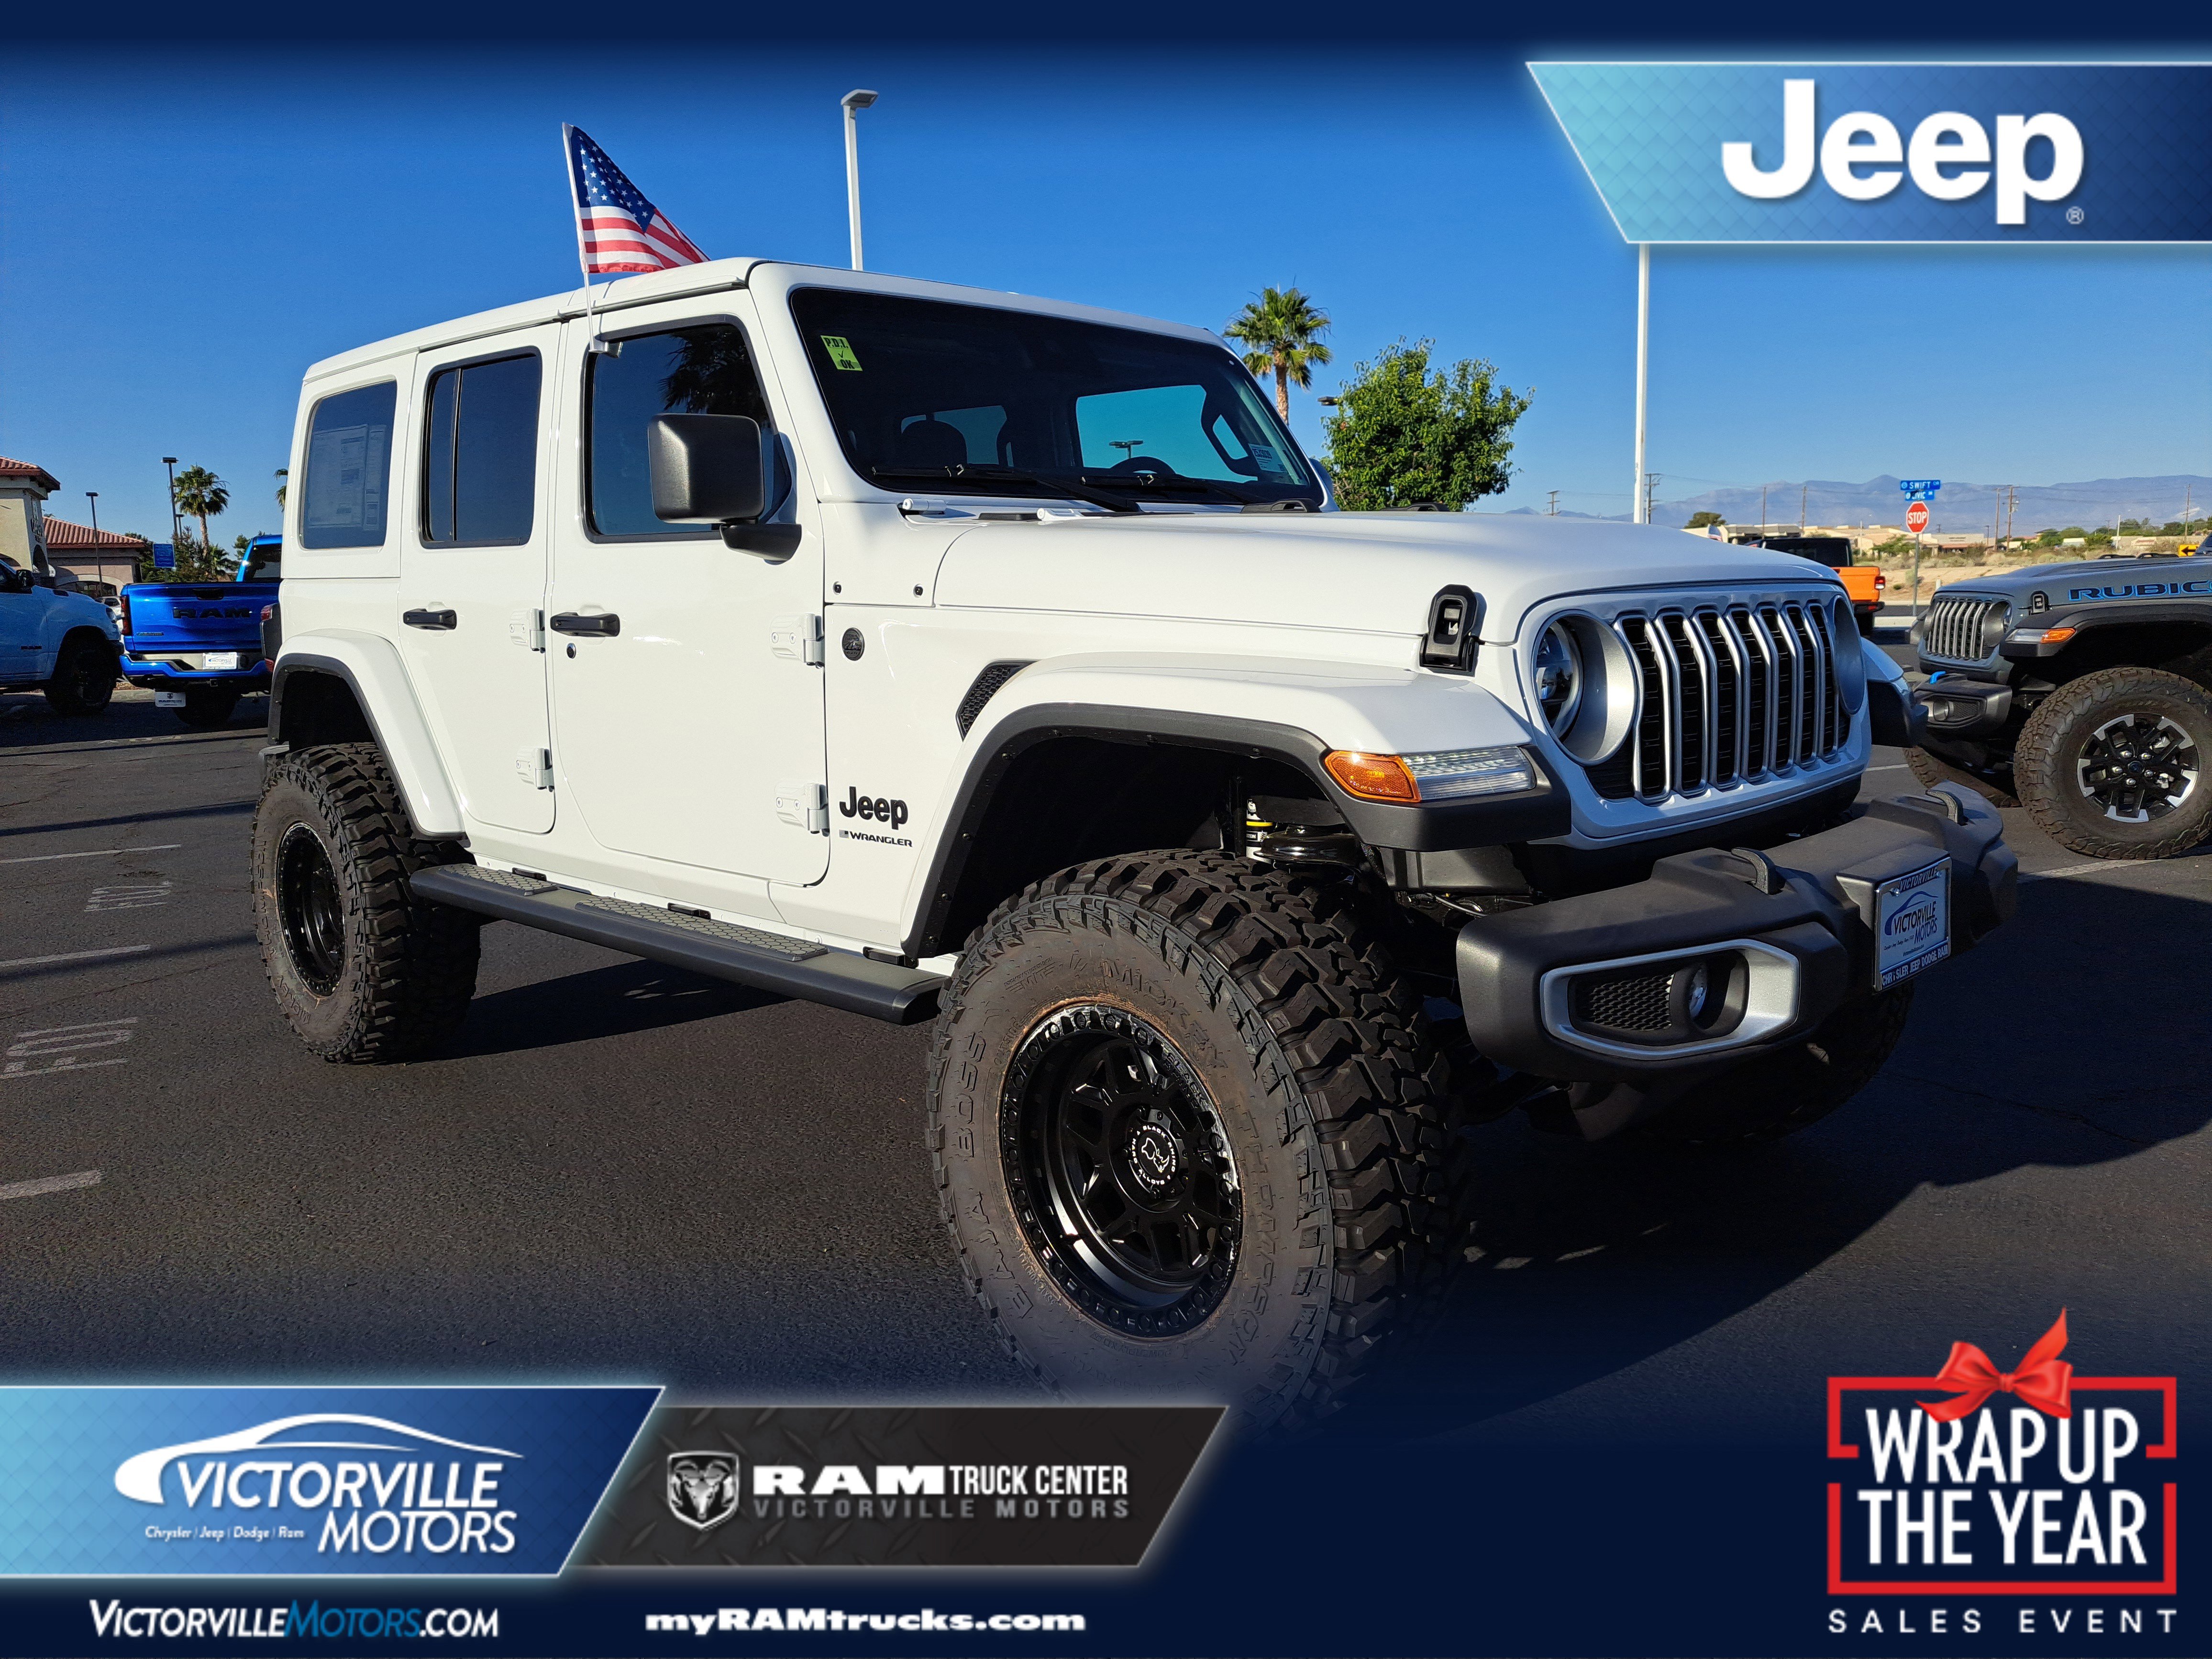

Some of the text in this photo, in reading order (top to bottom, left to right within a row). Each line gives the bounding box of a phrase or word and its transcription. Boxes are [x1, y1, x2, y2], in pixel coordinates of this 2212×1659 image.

[840, 359, 855, 369] OK
[1909, 481, 1931, 489] SWIFT
[1908, 511, 1927, 524] STOP
[2069, 580, 2212, 601] RUBIC
[173, 608, 251, 619] RAM
[839, 786, 908, 830] Jeep
[850, 831, 913, 847] WRANGLER
[1899, 867, 1937, 891] VICTORVILLE
[1894, 900, 1936, 935] VICTORVILLE
[1914, 918, 1938, 944] MOTORS
[1910, 958, 1921, 973] JEEP
[1921, 950, 1937, 966] DODGE
[1937, 944, 1948, 959] RAM
[1166, 1052, 1206, 1105] BLACK
[955, 1031, 987, 1159] BOSS
[1142, 1125, 1176, 1172] BLACK RHINO
